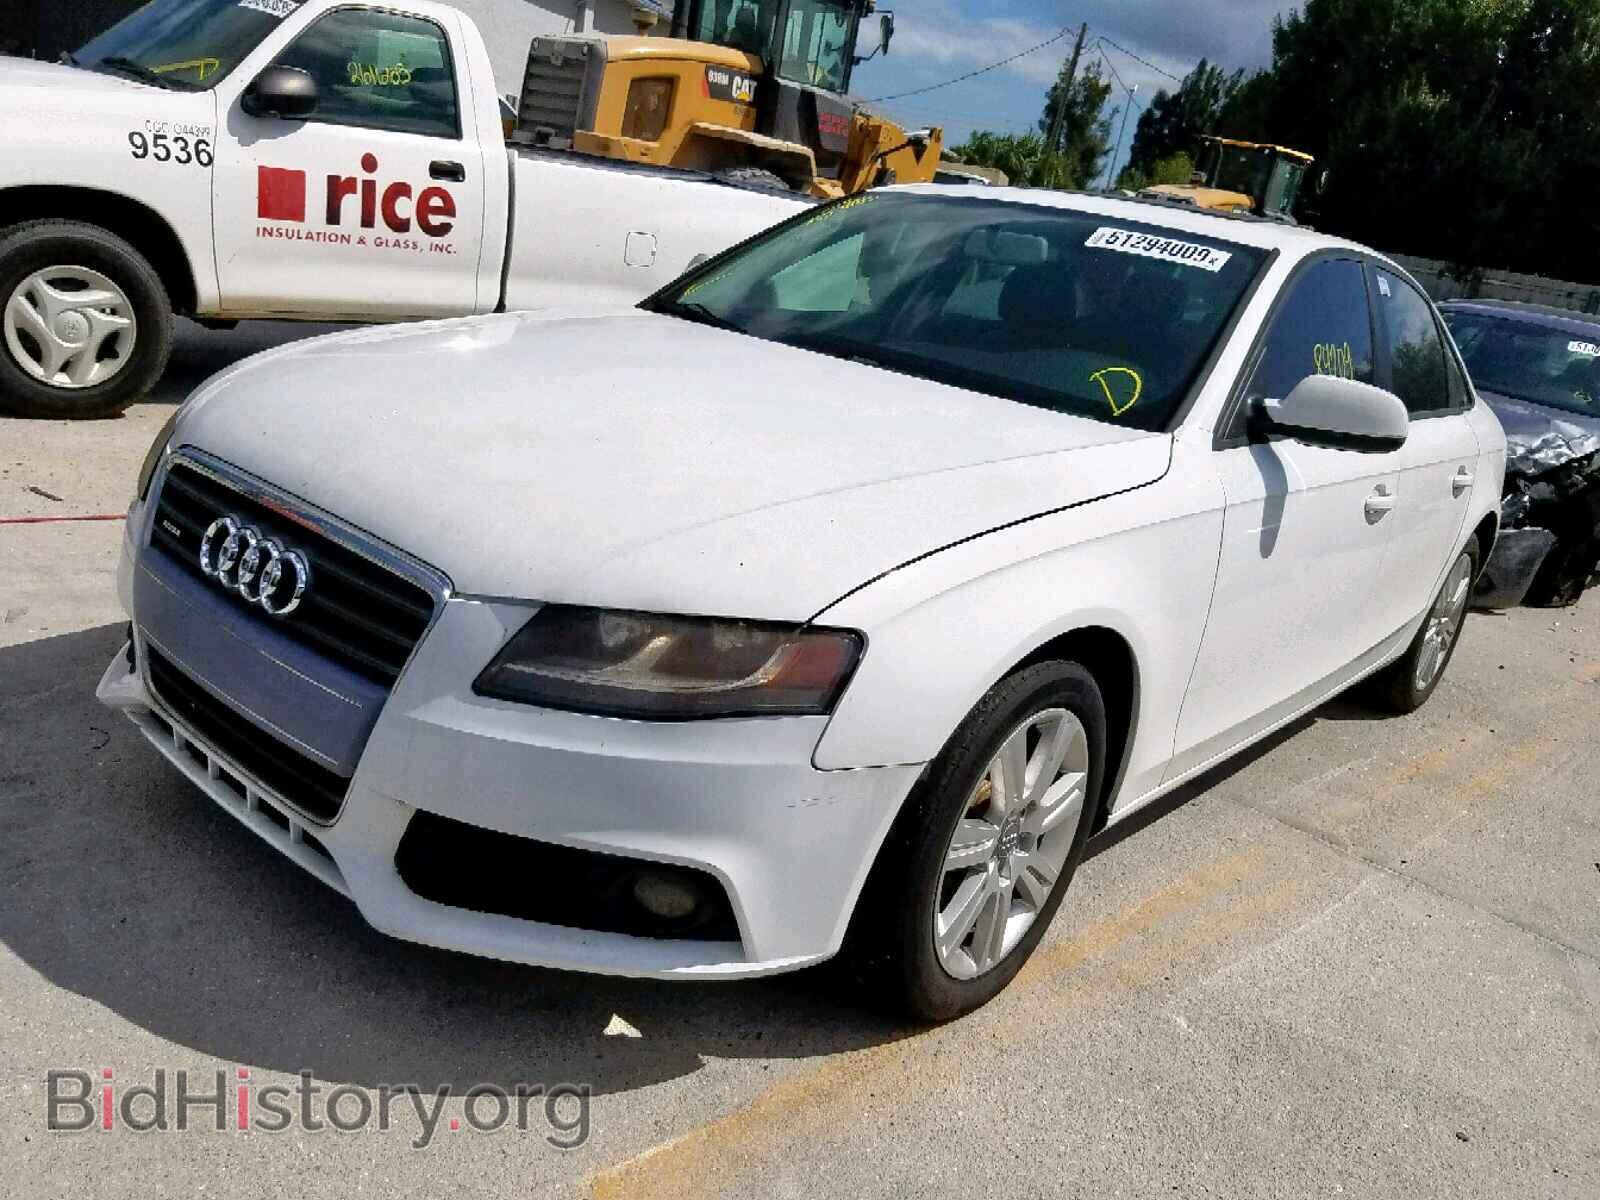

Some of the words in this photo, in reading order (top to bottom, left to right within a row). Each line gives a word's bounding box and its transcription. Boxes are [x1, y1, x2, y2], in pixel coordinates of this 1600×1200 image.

[731, 75, 757, 103] CAT
[127, 130, 213, 167] 9536
[326, 152, 457, 237] rice
[256, 226, 351, 245] INSULATION
[356, 232, 367, 246] &
[374, 235, 424, 253] GLASS,
[429, 242, 457, 255] INC.
[1089, 367, 1142, 416] D
